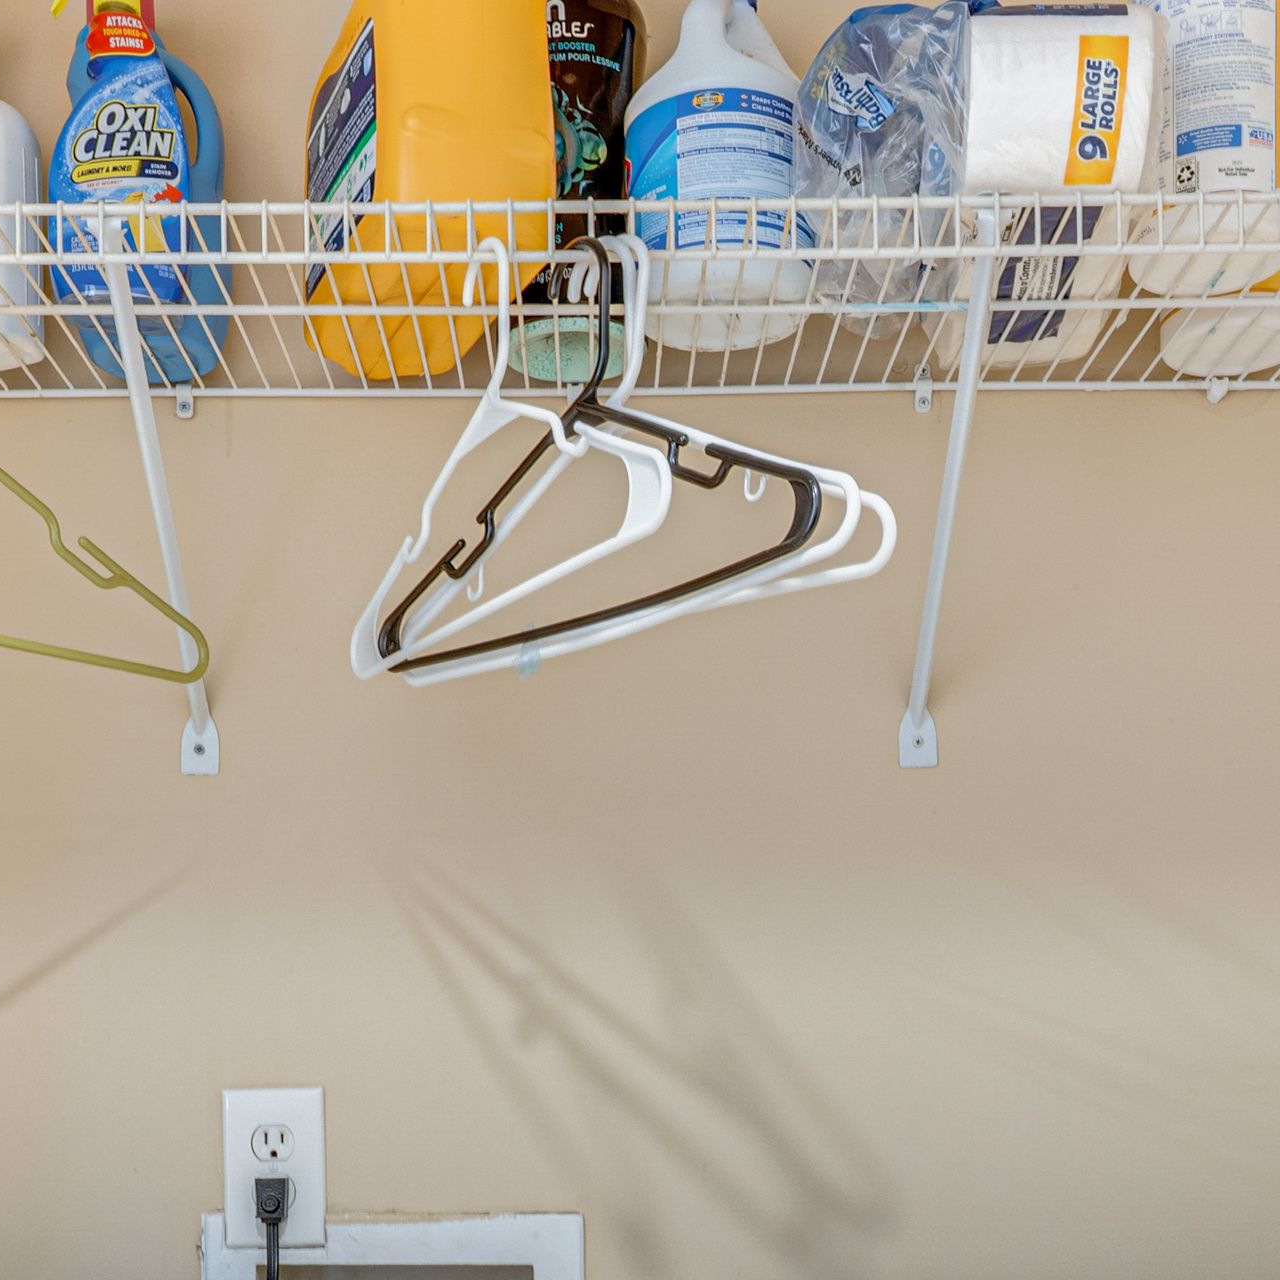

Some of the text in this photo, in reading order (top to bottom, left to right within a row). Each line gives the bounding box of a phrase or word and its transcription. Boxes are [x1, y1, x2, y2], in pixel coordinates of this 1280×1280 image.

[106, 16, 143, 29] ATTACKS
[110, 37, 144, 49] STAINS!
[558, 42, 595, 52] BOOSTER
[568, 53, 590, 61] POUR
[752, 95, 770, 104] Keeps
[1077, 59, 1108, 160] 9 LARGE
[97, 102, 156, 134] OXI
[74, 129, 173, 163] CLEAN
[77, 167, 104, 178] LAUNDRY
